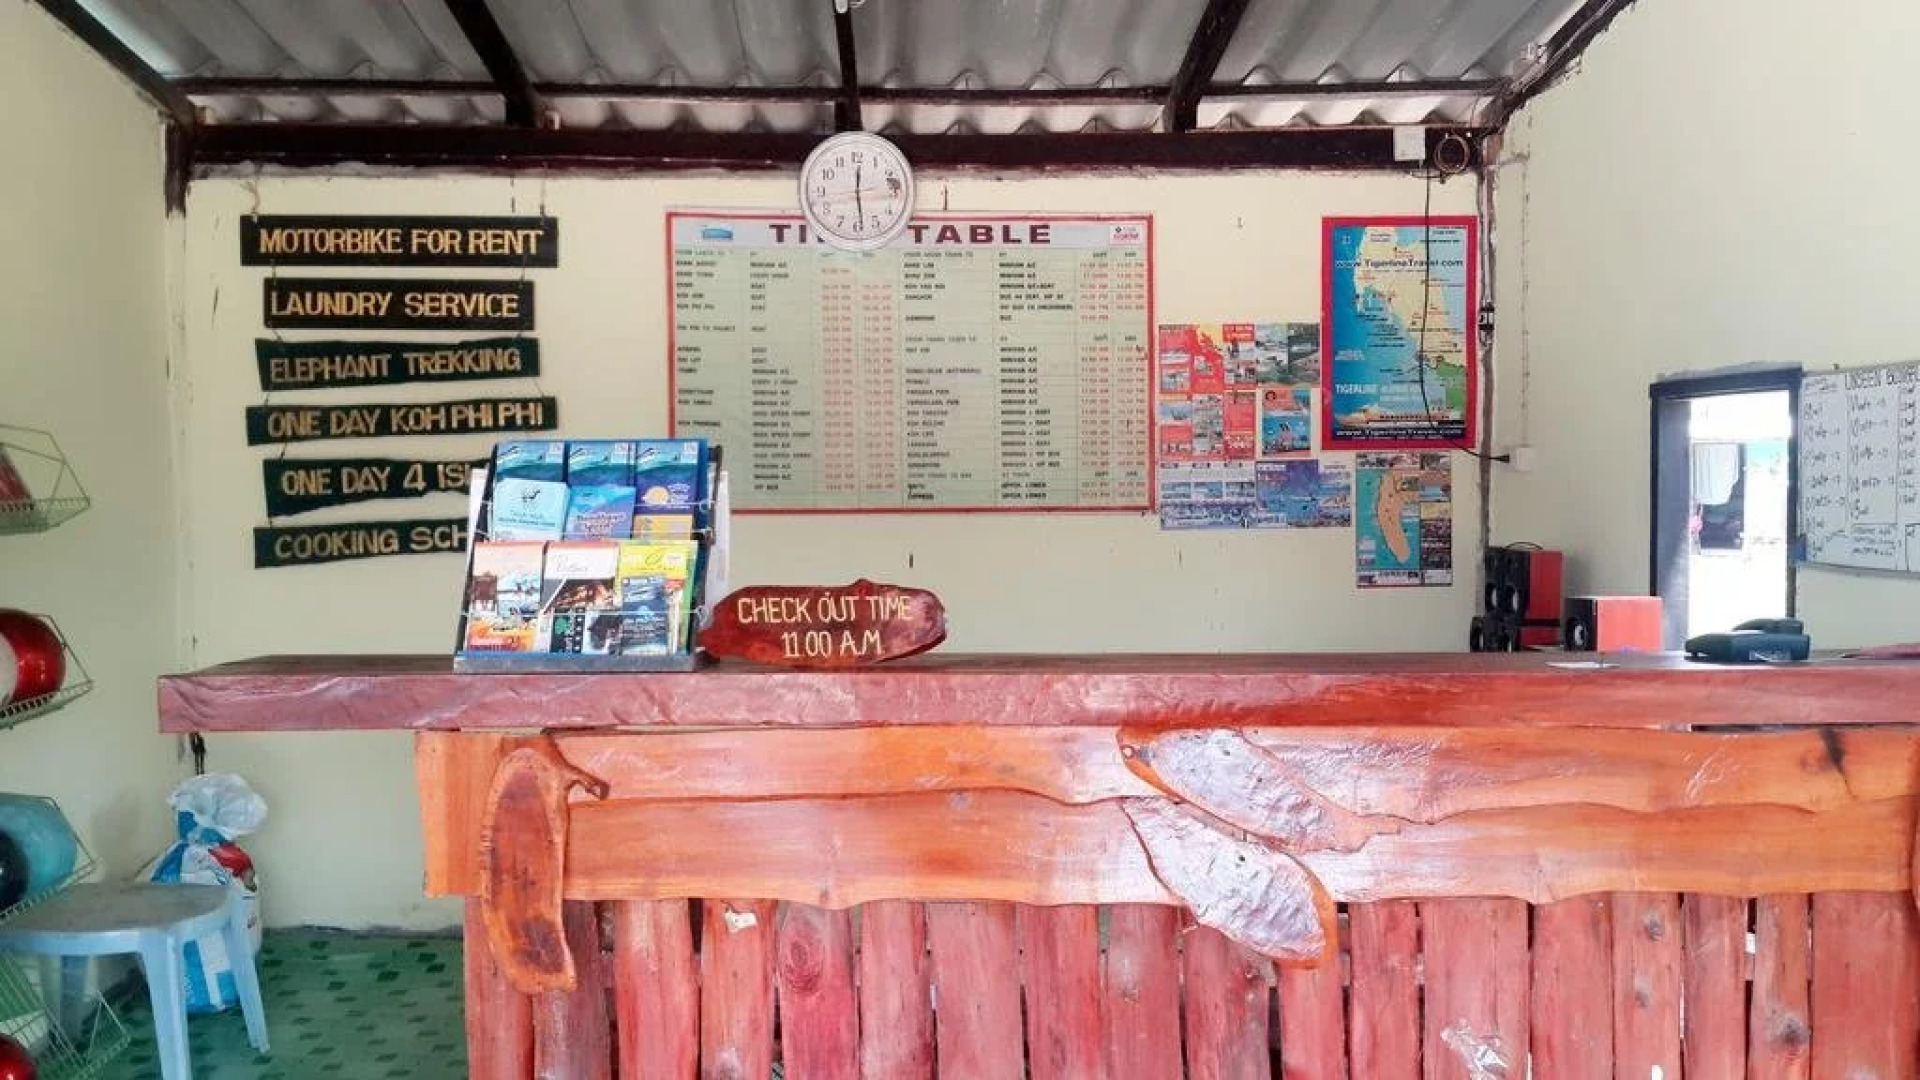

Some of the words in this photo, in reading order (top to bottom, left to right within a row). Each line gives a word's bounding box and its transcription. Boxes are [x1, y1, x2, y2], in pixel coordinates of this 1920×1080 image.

[851, 151, 863, 164] 12
[823, 167, 834, 181] 10
[259, 228, 402, 254] MOTORBIKE
[411, 229, 463, 254] FOR
[468, 230, 543, 255] RENT
[907, 224, 1050, 244] TABLE
[270, 291, 392, 317] LAUNDRY
[404, 293, 519, 318] SERVICE
[268, 353, 392, 382] ELEPHANT
[402, 348, 522, 375] TREKKING
[266, 408, 322, 438] ONE
[328, 407, 382, 436] DAY
[391, 405, 446, 433] KOH
[450, 403, 493, 429] PHI
[498, 402, 543, 427] PHI
[281, 469, 331, 494] ONE
[341, 466, 392, 494] DAY
[403, 463, 427, 492] 4
[274, 530, 399, 560] COOKING
[409, 524, 469, 551] SCH
[738, 597, 812, 624] CHECK
[817, 596, 859, 622] OUT
[866, 595, 913, 621] TIME
